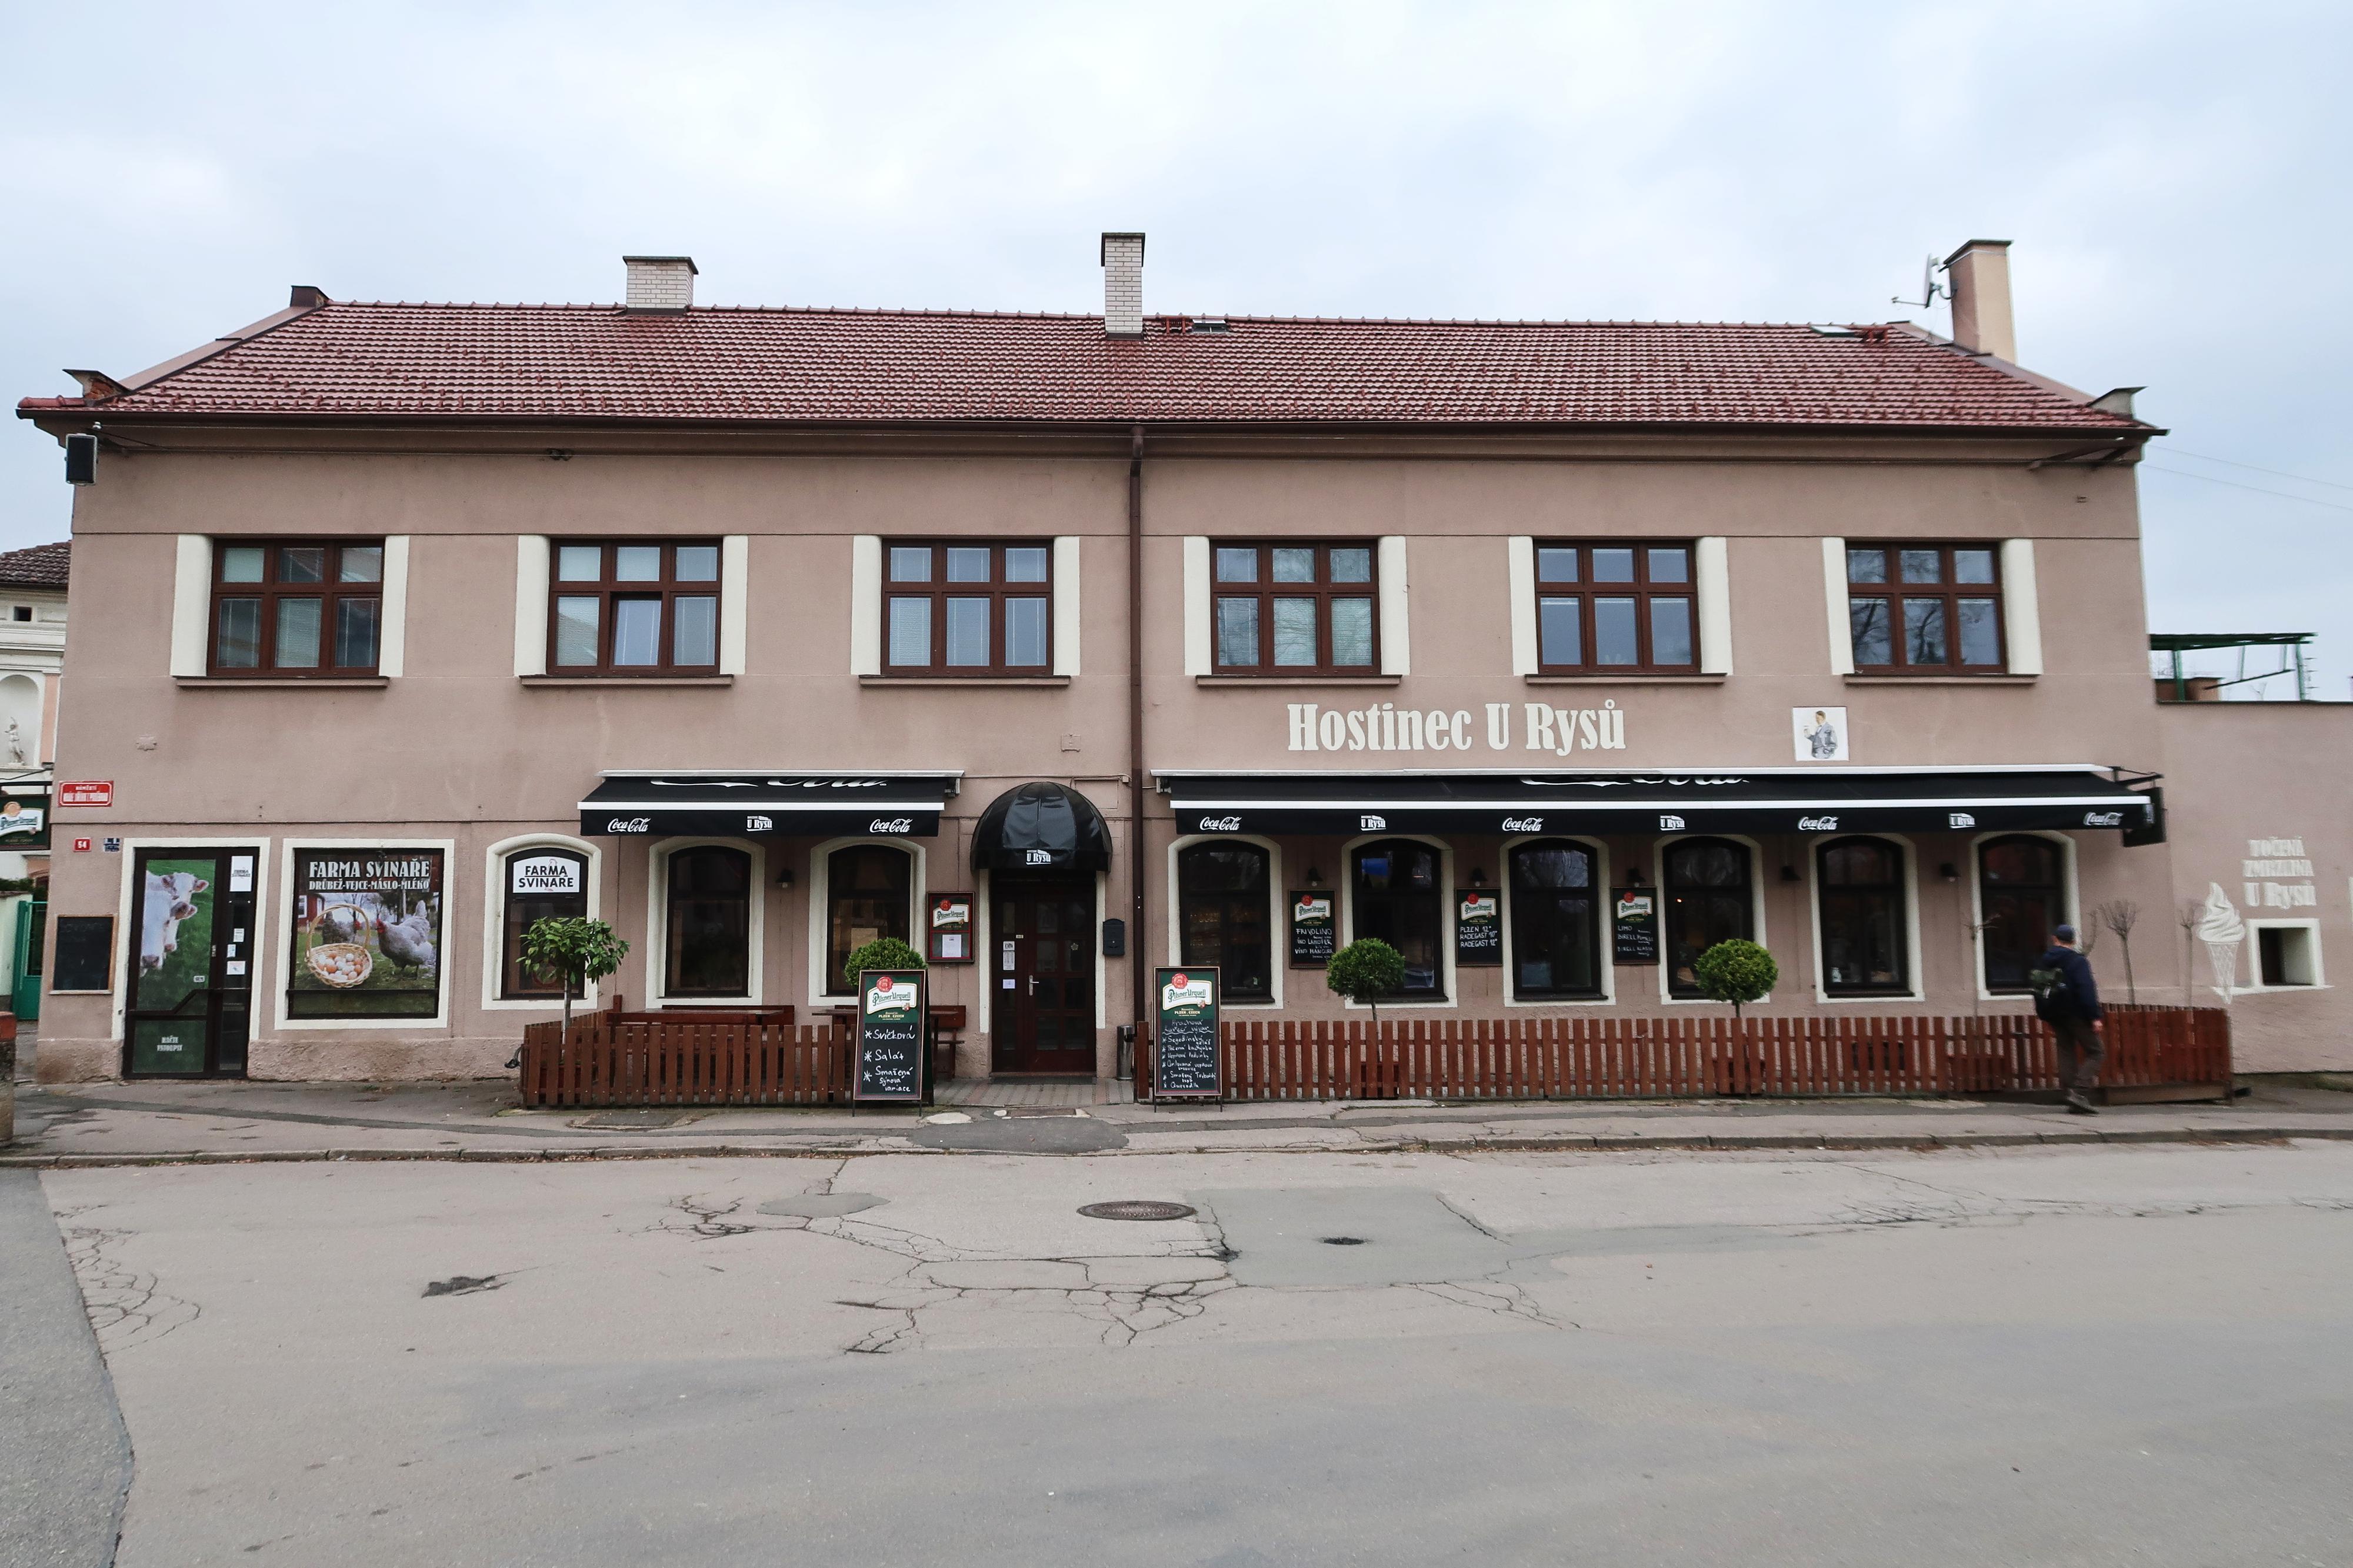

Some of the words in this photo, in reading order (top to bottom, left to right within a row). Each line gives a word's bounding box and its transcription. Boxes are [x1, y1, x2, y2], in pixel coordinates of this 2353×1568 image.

[1288, 703, 1472, 750] Hostinec
[1485, 703, 1510, 750] U
[1525, 699, 1626, 756] Rysů
[608, 818, 628, 832] Coca
[627, 818, 651, 832] Cola
[747, 819, 752, 828] U
[869, 819, 890, 832] Coca
[889, 819, 913, 832] Cola
[1199, 816, 1219, 830] Coca
[1218, 816, 1242, 830] Cola
[1361, 819, 1365, 828] U
[1502, 817, 1522, 831] Coca
[1521, 818, 1544, 831] Cola
[1660, 819, 1665, 828] U
[1798, 816, 1818, 830] Coca
[1817, 816, 1839, 830] Cola
[1026, 853, 1031, 862] U
[309, 861, 361, 878] FARMA
[366, 858, 430, 878] SVINAŘE
[525, 866, 567, 875] FARMA
[1460, 939, 1488, 948] RADEGAST
[872, 992, 892, 1006] Pilsner
[892, 992, 911, 1002] Urquell
[1168, 989, 1187, 1003] Pilsner
[1187, 989, 1206, 999] Urquell
[872, 1025, 915, 1040] Svíčková
[875, 1049, 904, 1061] Salát
[875, 1066, 914, 1076] Smažená
[885, 1084, 911, 1092] variace
